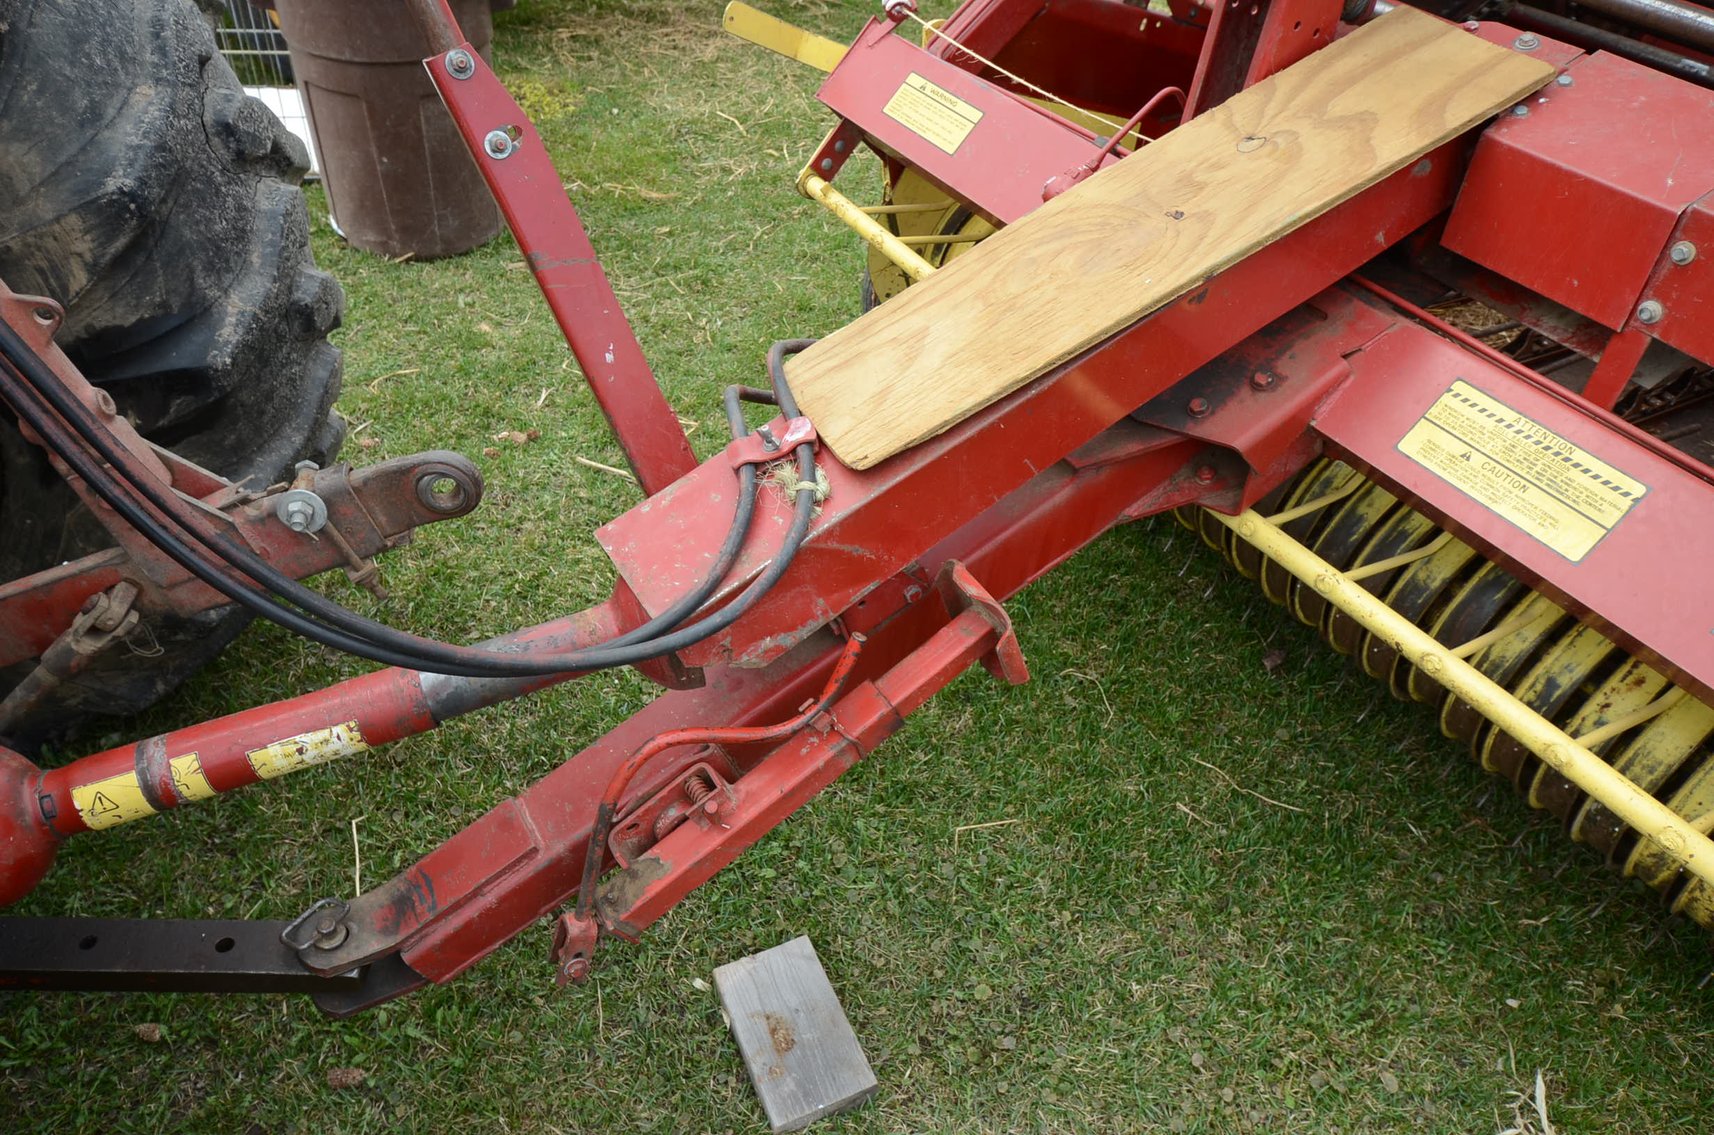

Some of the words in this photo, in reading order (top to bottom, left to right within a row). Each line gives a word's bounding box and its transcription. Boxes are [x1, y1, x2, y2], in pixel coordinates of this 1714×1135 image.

[930, 87, 958, 107] WARNING
[1492, 422, 1510, 436] ROLL
[1532, 446, 1572, 473] OPERATION
[1513, 416, 1577, 455] ATTENTION
[1481, 461, 1530, 494] CAUTION
